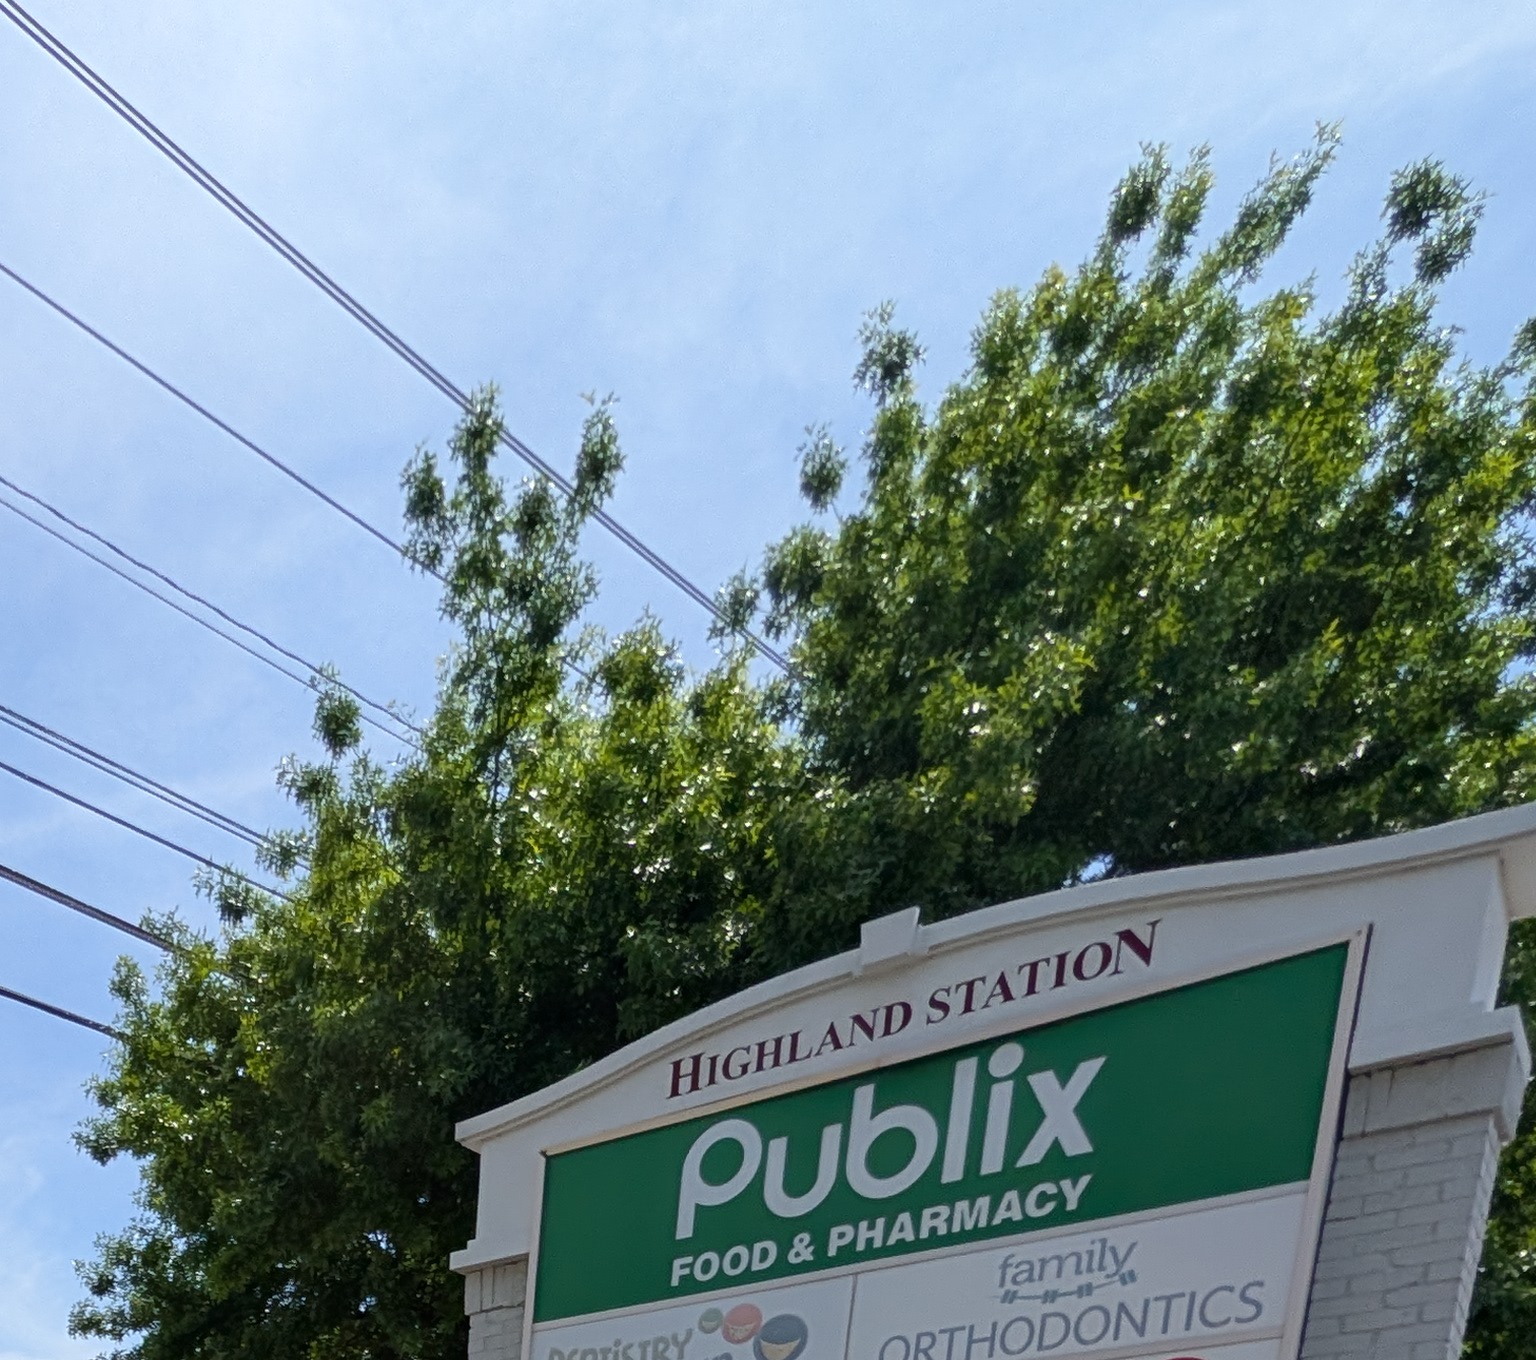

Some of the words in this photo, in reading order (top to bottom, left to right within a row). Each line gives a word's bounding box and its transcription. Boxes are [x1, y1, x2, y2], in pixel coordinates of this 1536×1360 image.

[666, 1000, 913, 1099] HIGHLAND
[926, 918, 1162, 1026] STATION
[674, 1042, 1108, 1240] Publix
[671, 1239, 778, 1288] FOOD
[787, 1232, 816, 1264] &
[827, 1174, 1093, 1258] PHARMACY
[998, 1237, 1138, 1290] family
